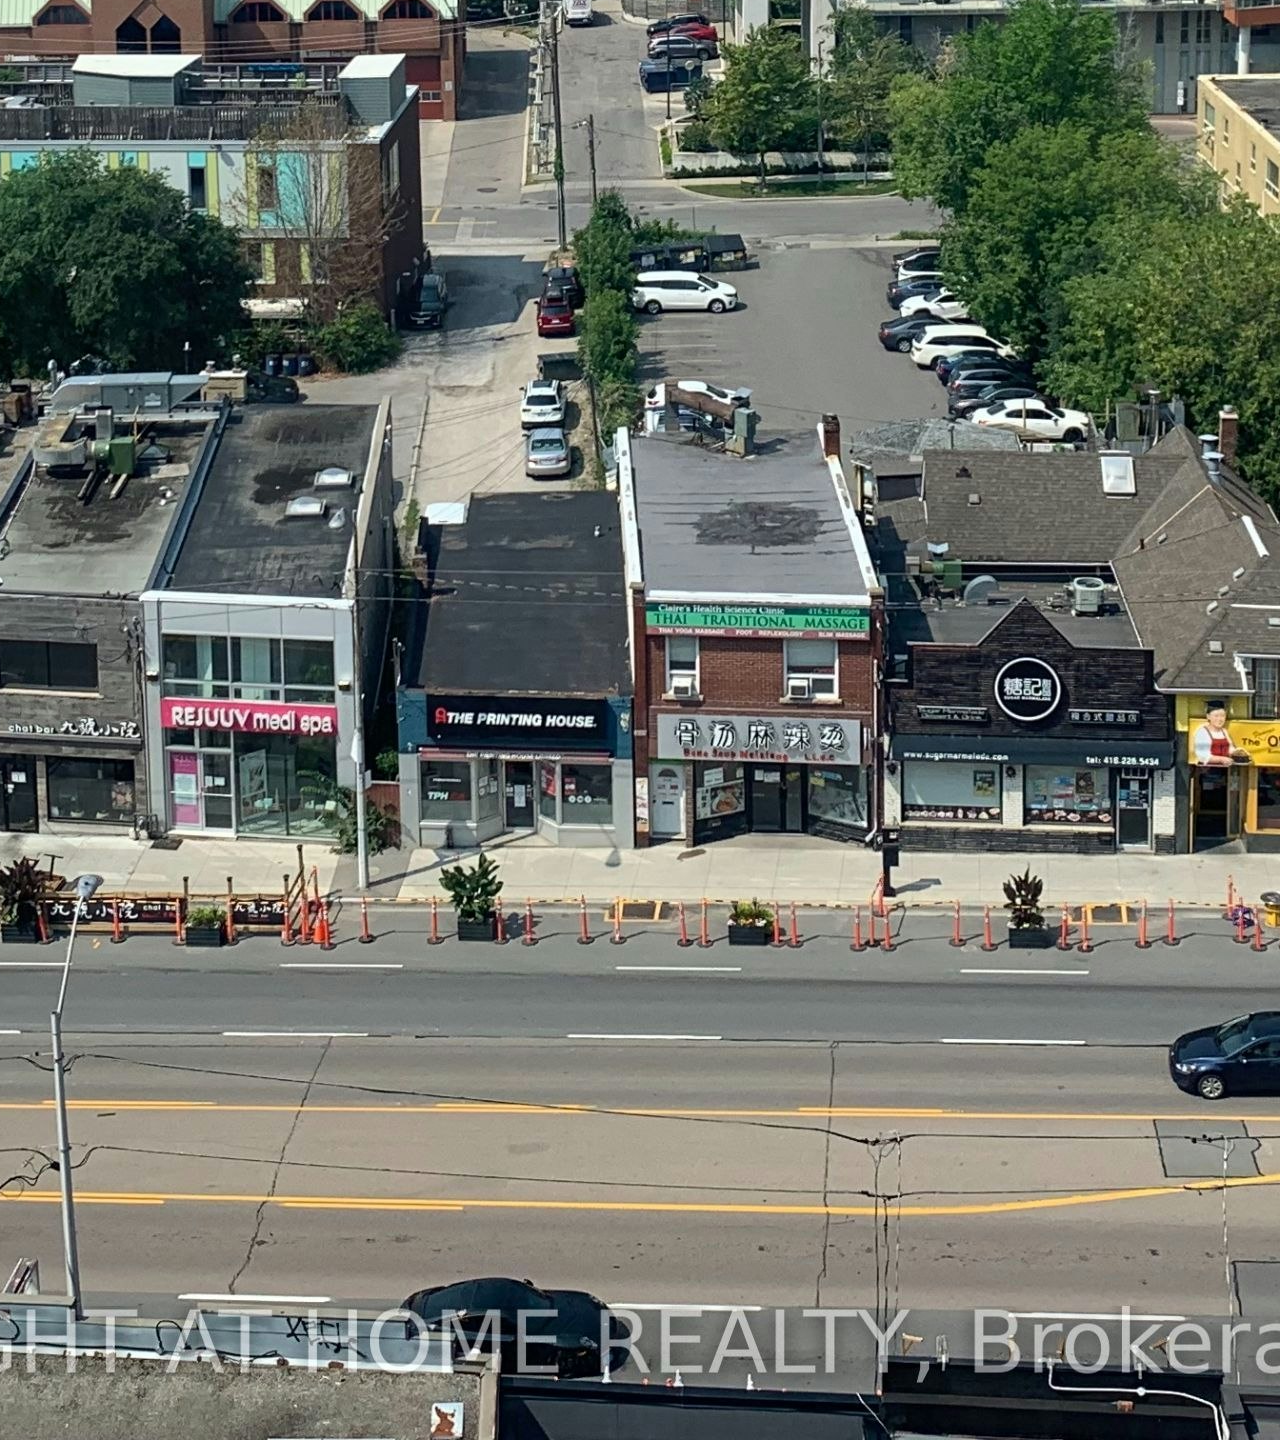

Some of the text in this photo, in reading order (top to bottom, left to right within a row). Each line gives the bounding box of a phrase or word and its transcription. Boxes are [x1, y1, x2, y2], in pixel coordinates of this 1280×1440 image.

[658, 604, 691, 613] Claire's
[693, 605, 722, 613] Health
[724, 606, 757, 614] Science
[759, 607, 785, 615] Clinic
[654, 613, 866, 630] THAI TRADITIONAL MASSAGE
[172, 706, 333, 736] REJUUV medi spa
[447, 712, 474, 725] THE
[476, 713, 542, 727] PRINTING
[60, 718, 141, 738] 九號小院
[675, 718, 845, 751] 骨汤麻辣烫
[1242, 737, 1260, 746] The
[428, 792, 449, 801] TPH
